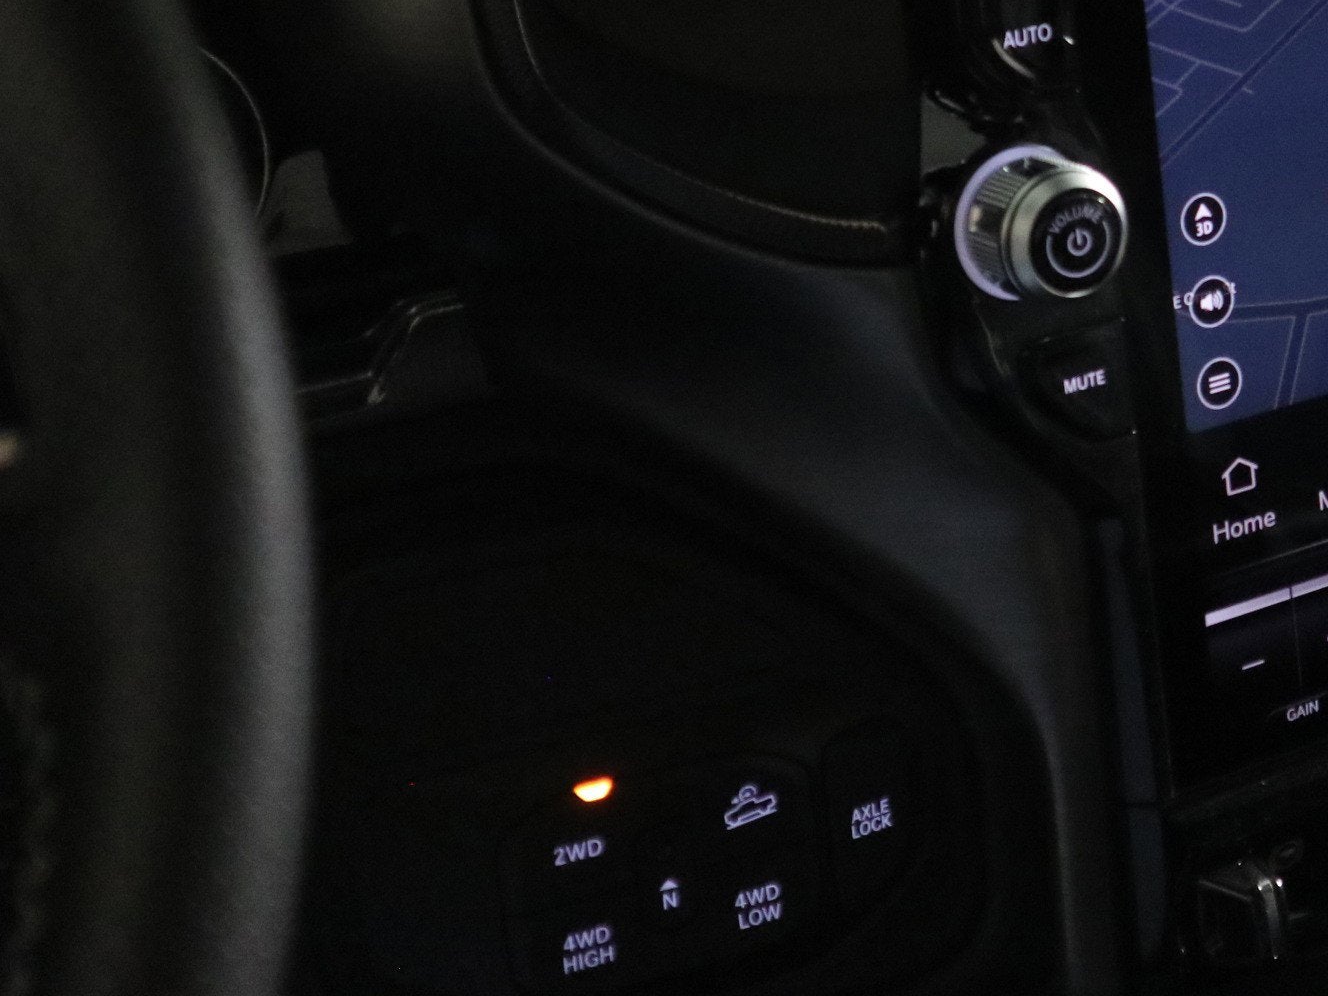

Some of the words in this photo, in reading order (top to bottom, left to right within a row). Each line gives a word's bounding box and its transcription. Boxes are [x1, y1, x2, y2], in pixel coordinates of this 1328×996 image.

[1002, 22, 1053, 50] AUTO
[1063, 368, 1106, 395] MUTE
[1212, 510, 1277, 545] Home
[1286, 699, 1320, 722] GAIN
[851, 798, 890, 824] AXLE
[851, 813, 894, 840] LOCK
[554, 838, 603, 866] 2WD
[663, 893, 679, 910] N
[735, 883, 780, 908] 4WD
[739, 903, 782, 931] LOW
[563, 926, 611, 952] 4WD
[563, 945, 615, 975] HIGH
